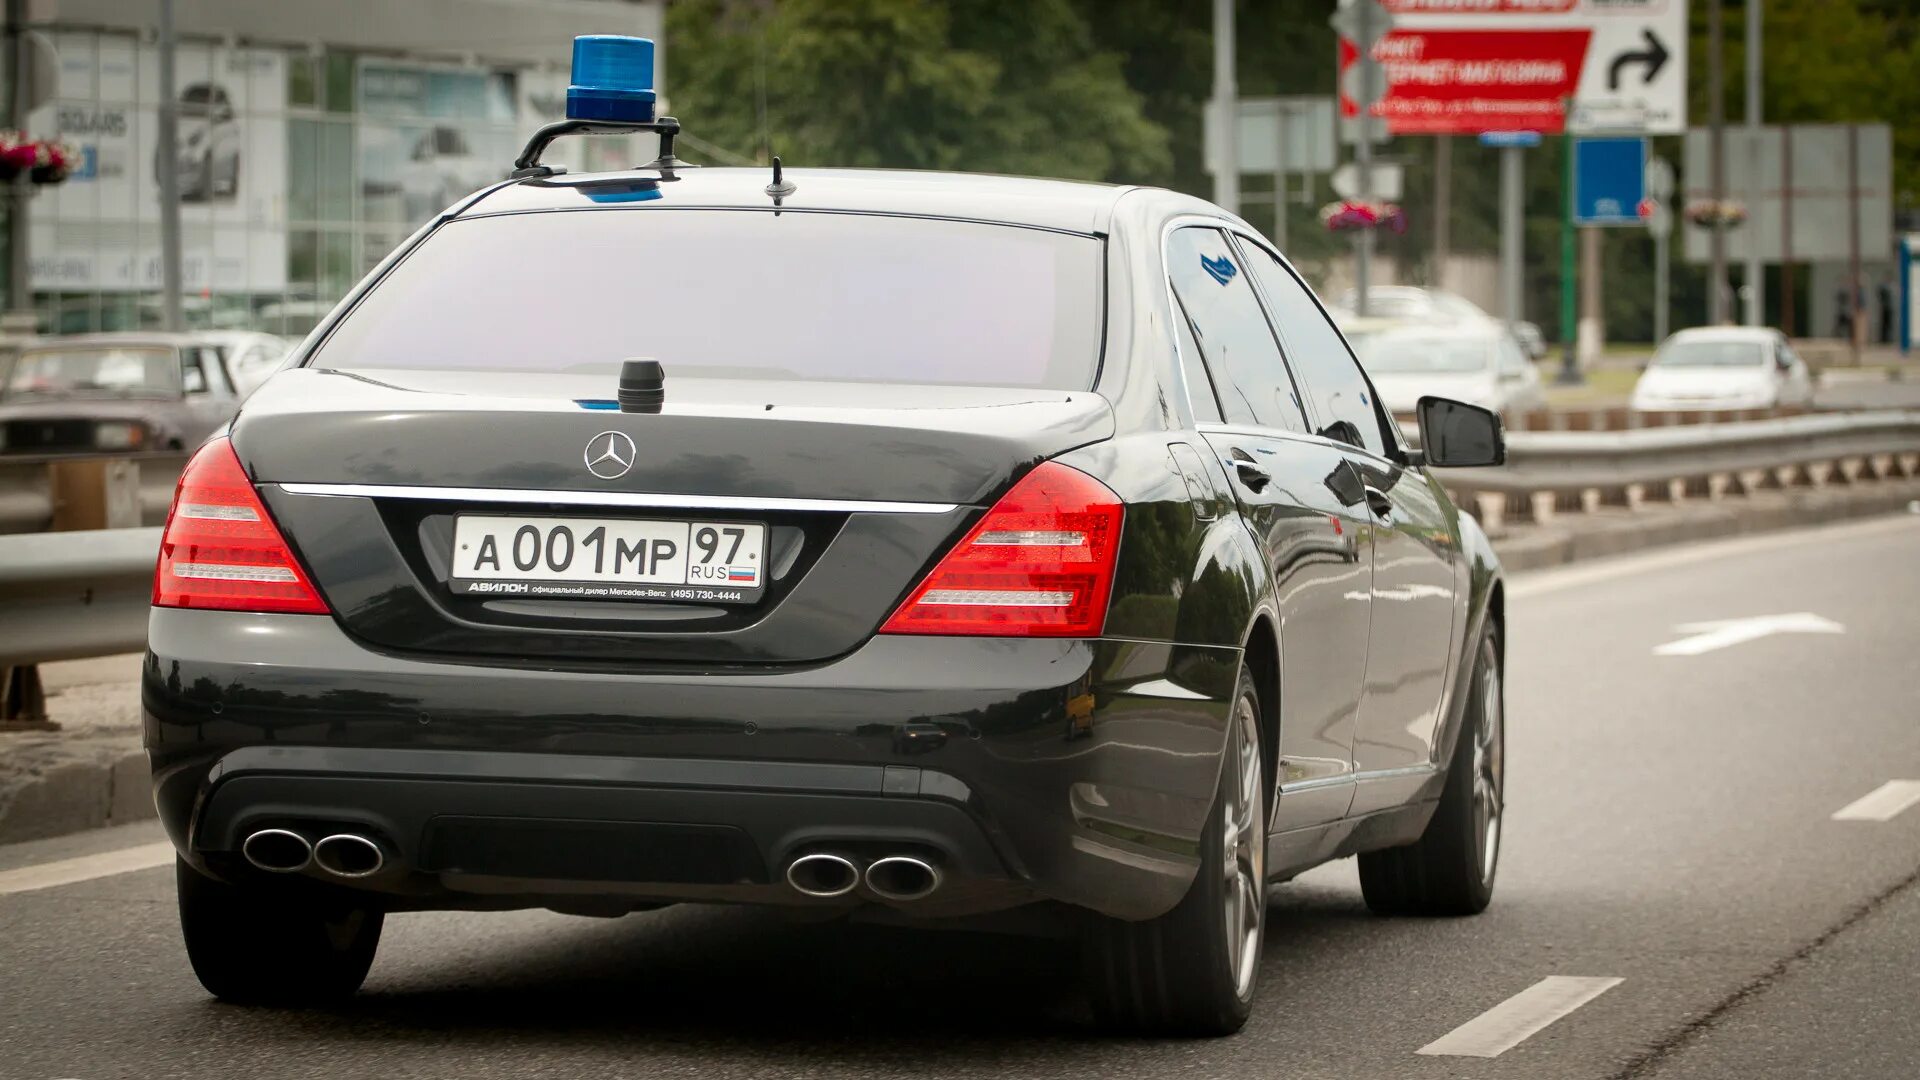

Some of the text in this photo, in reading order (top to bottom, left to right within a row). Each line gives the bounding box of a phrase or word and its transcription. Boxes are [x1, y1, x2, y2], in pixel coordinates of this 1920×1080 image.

[696, 527, 745, 565] 97
[691, 565, 727, 579] RUS
[468, 582, 741, 600] АВИЛОН официальный дилер Mercedes-Benz (495) 730-4444
